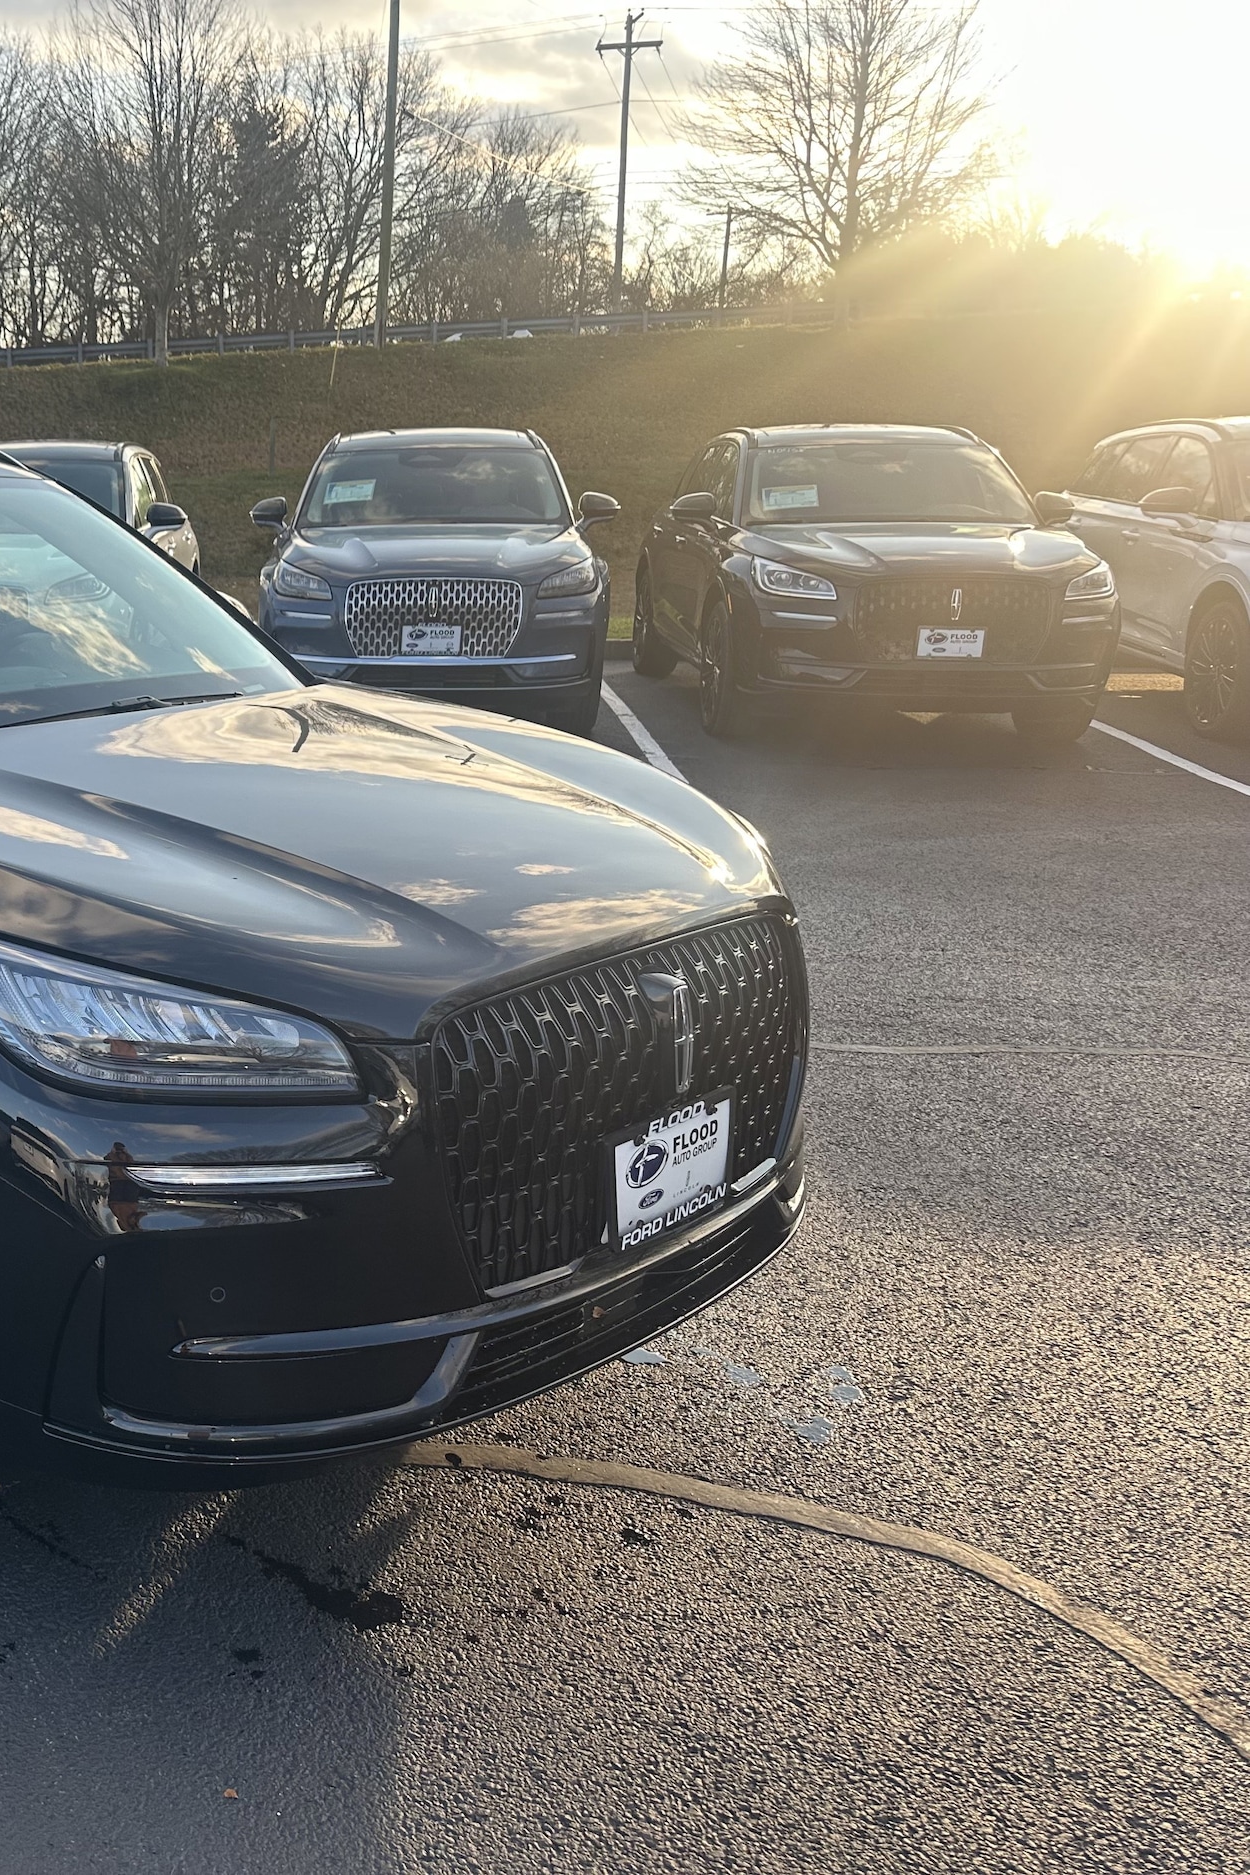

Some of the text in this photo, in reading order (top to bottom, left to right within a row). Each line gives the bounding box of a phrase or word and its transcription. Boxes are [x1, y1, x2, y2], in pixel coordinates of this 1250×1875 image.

[648, 1101, 705, 1136] FLOOD
[671, 1138, 717, 1167] AUTO GROUP
[672, 1119, 718, 1153] FLOOD
[622, 1183, 727, 1250] FORD LINCOLN
